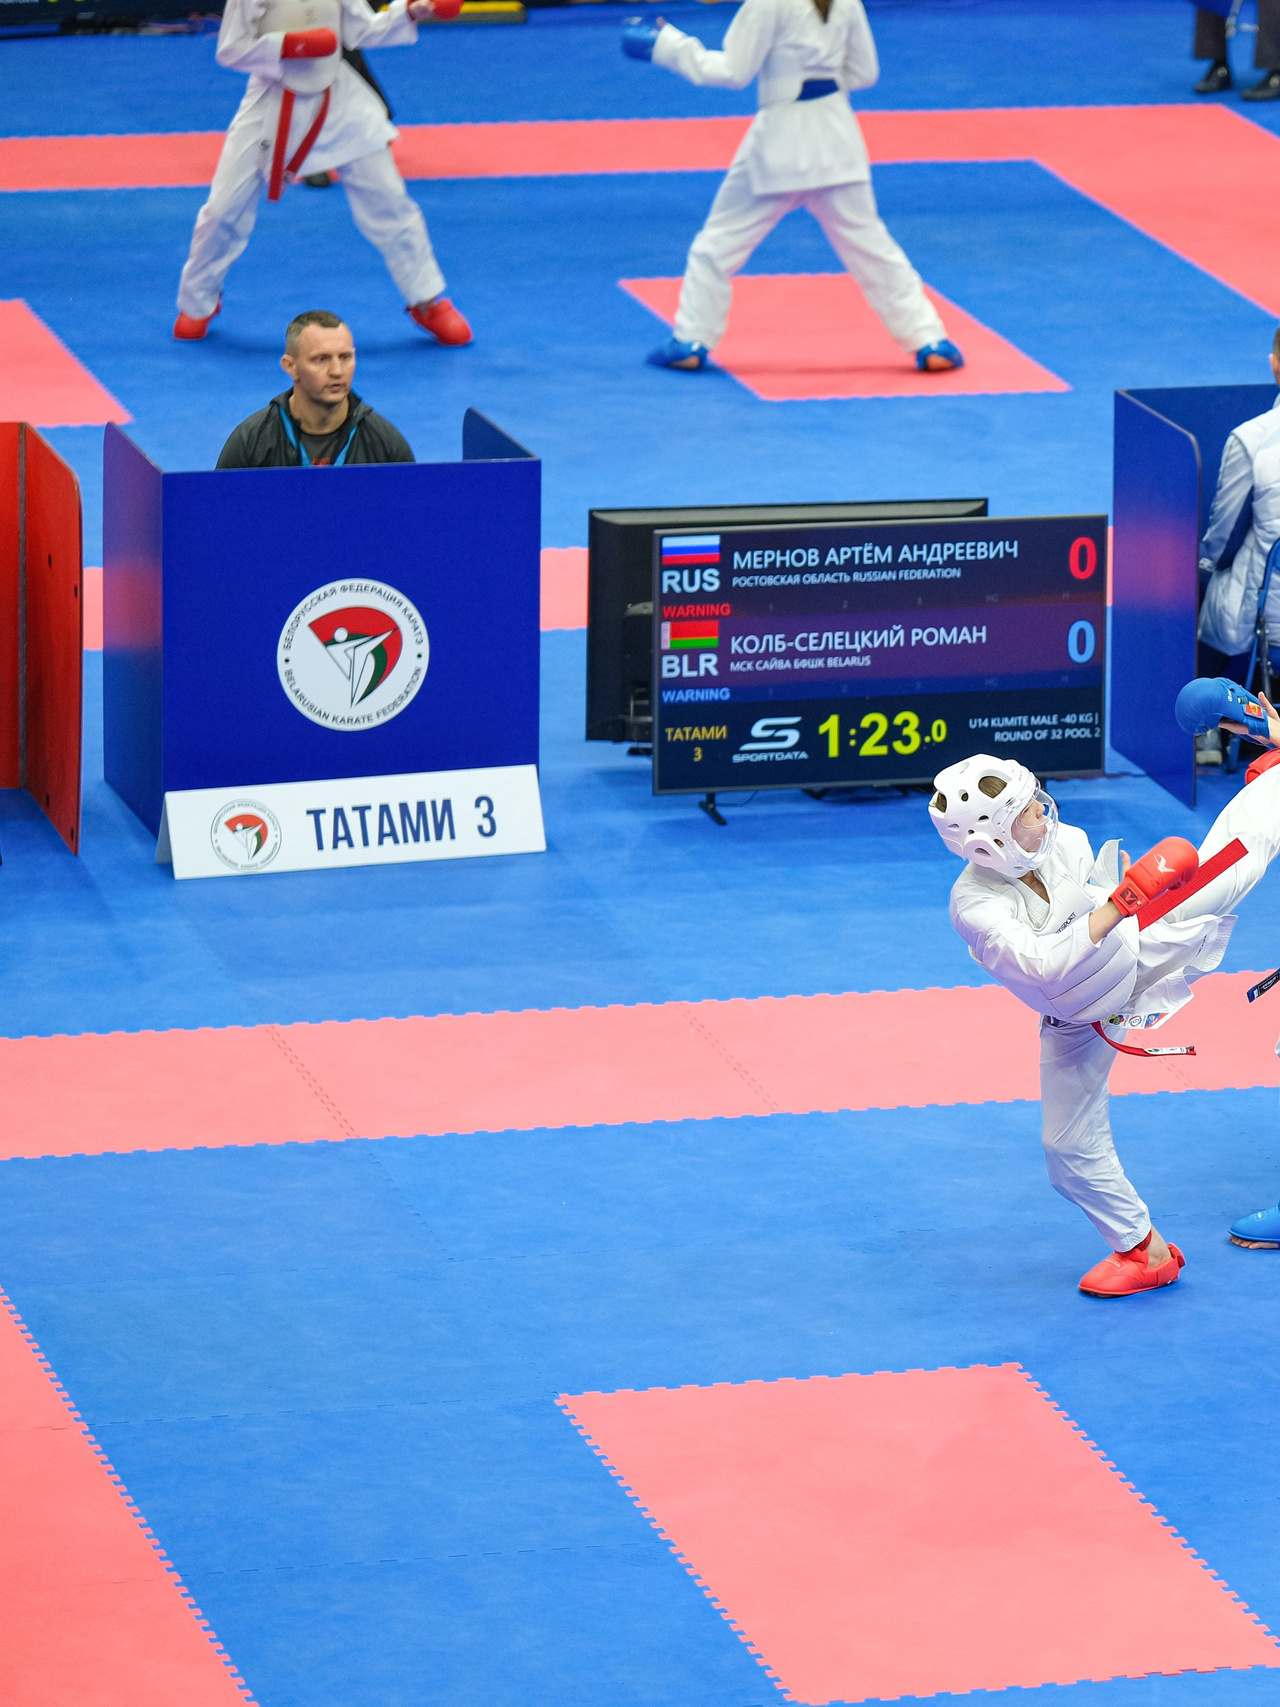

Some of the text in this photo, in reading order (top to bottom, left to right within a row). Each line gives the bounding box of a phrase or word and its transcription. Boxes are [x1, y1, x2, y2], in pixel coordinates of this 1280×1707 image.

[732, 540, 1019, 570] МЕРНОВ АРТЁМ АНДРЕЕВИЧ
[1068, 536, 1098, 580] 0
[661, 568, 720, 594] RUS
[732, 567, 961, 588] РОСТОВСКАЯ ОБЛАСТЬ RUSSIAN FEDERATION
[662, 603, 731, 618] WARNING
[401, 607, 424, 645] КАРАТЭ
[730, 624, 987, 655] КОЛБ-СЕЛЕЦКИЙ РОМАН
[1067, 620, 1096, 664] 0
[661, 653, 719, 678] BLR
[730, 661, 753, 672] МСК
[827, 655, 871, 668] BELARUS
[284, 666, 422, 725] BELARUSIAN KARATE FEDERATION
[662, 687, 731, 703] WARNING
[969, 717, 989, 729] U14
[991, 715, 1028, 728] KUMITE
[1030, 714, 1058, 726] MALE
[1060, 713, 1077, 725] -40
[1078, 712, 1093, 724] KG
[665, 725, 728, 742] ТАТАМИ
[994, 726, 1101, 743] ROUND OF 32 POOL 2
[693, 747, 702, 762] 3
[732, 751, 809, 763] SPORTDATA
[305, 798, 457, 852] ТАТАМИ
[473, 795, 498, 839] 3
